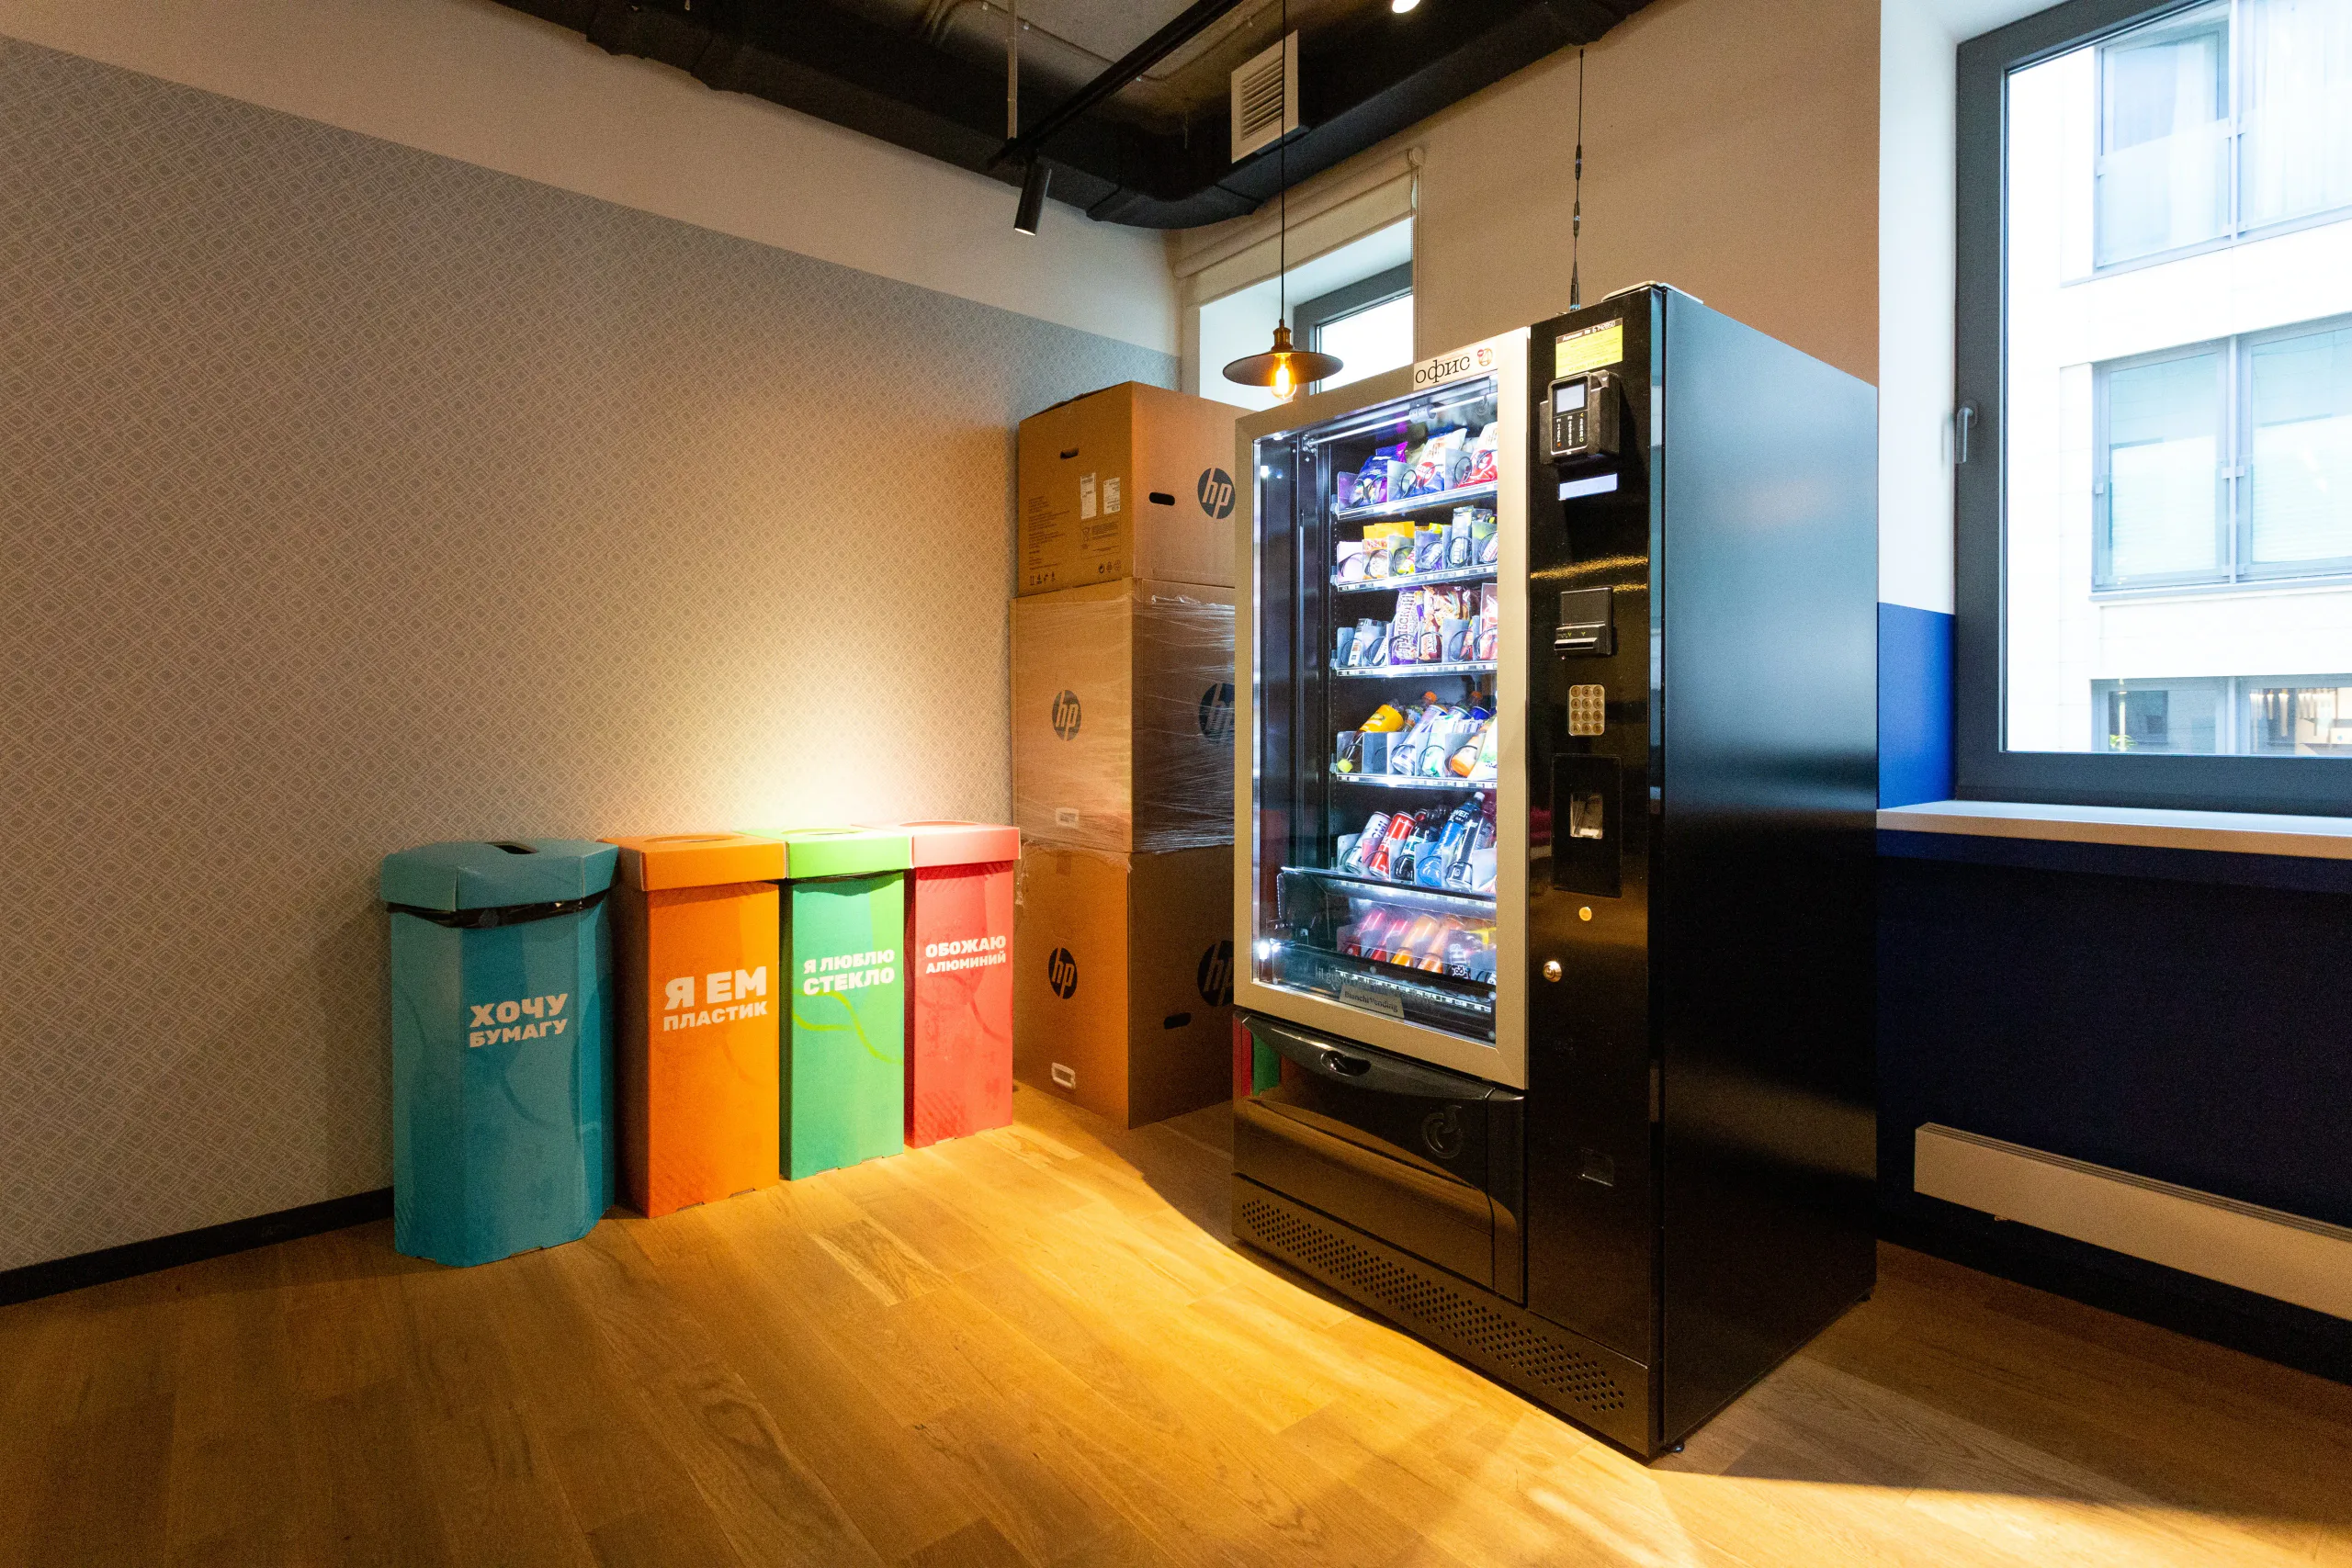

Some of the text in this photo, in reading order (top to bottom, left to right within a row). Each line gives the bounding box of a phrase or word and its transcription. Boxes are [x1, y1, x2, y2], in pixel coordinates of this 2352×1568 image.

[1415, 356, 1471, 384] офис
[1201, 468, 1233, 519] hp
[1054, 690, 1080, 741] hp
[803, 949, 895, 974] Я ЛЮБЛЮ
[925, 935, 1006, 958] ОБОЖАЮ
[925, 951, 1006, 974] АЛЮМИНИЙ
[1051, 947, 1076, 999] hp
[664, 966, 767, 1010] Я ЕМ
[803, 967, 895, 995] СТЕКЛО
[469, 993, 568, 1027] ХОЧУ
[663, 1001, 767, 1032] ПЛАСТИК
[469, 1018, 568, 1048] БУМАГУ
